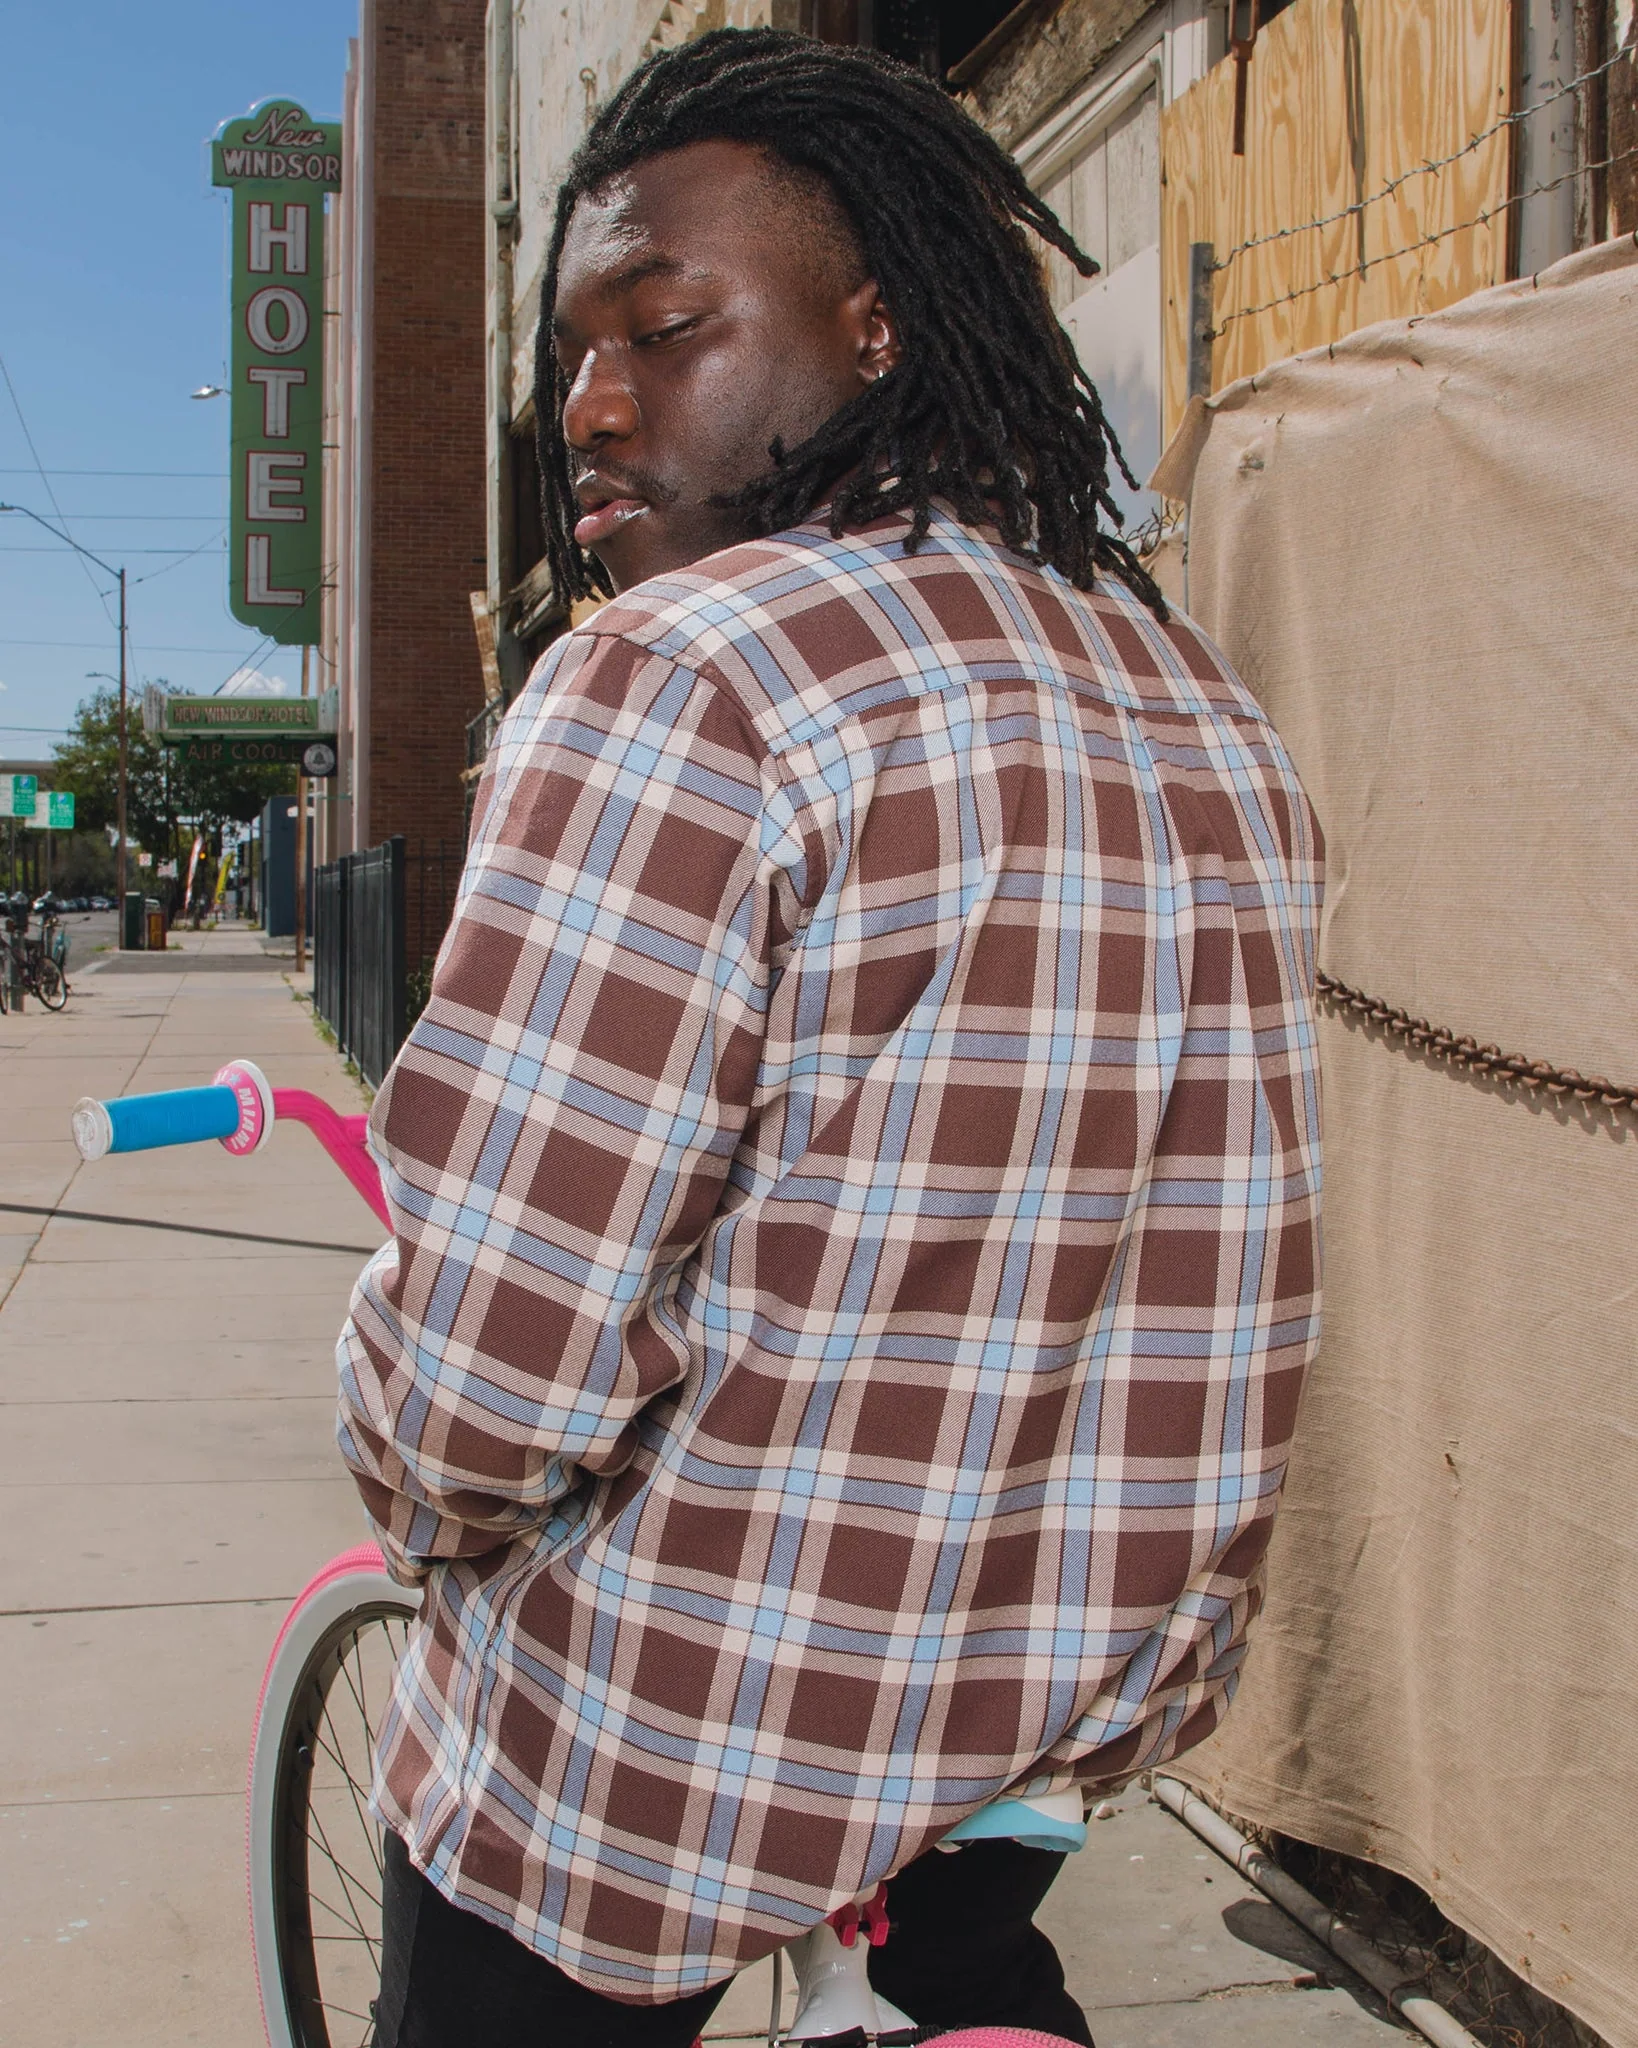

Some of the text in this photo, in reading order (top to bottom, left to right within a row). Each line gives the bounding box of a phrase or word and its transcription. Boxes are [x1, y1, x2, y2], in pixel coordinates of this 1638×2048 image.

[243, 109, 326, 147] New
[221, 147, 340, 182] WINDSOR
[245, 202, 310, 607] HOTEL
[174, 705, 312, 724] NEW WINDSOR HOTEL
[187, 743, 223, 760] AIR
